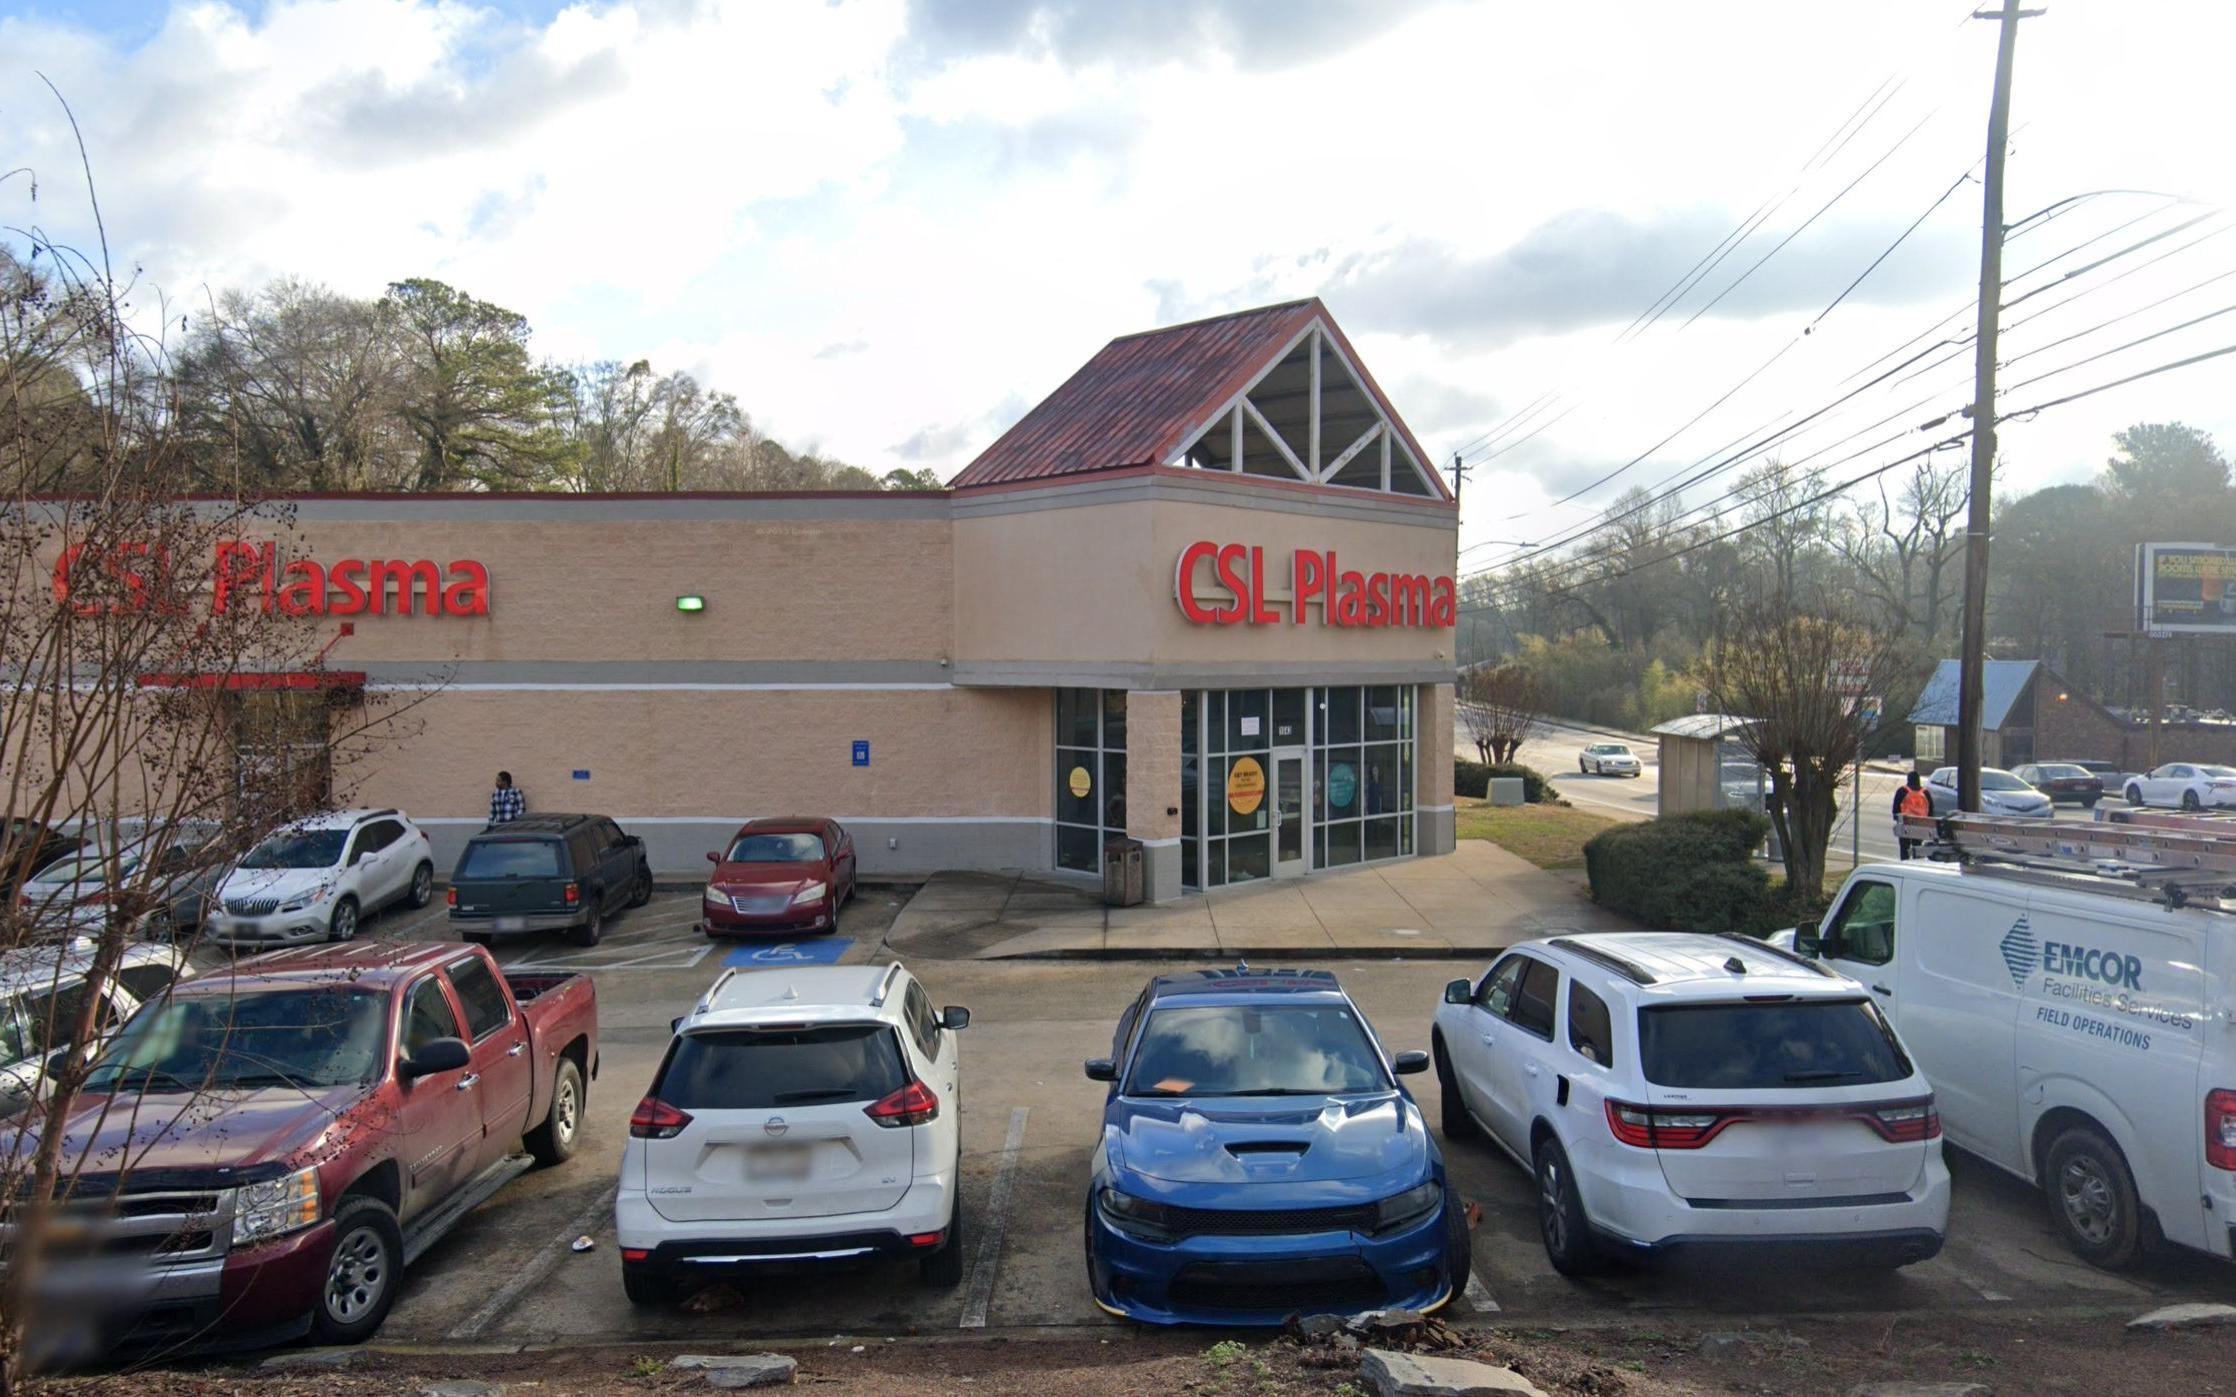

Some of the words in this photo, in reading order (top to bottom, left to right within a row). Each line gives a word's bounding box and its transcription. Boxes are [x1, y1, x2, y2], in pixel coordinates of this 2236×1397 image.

[212, 541, 490, 617] Plasma
[1175, 541, 1280, 624] CSL
[1292, 549, 1456, 627] Plasma
[2043, 941, 2142, 991] EMCOR
[2037, 1006, 2070, 1027] FIELD
[2072, 1015, 2151, 1050] OPERATIONS
[2043, 978, 2113, 1009] Facilities
[2115, 993, 2193, 1030] Services
